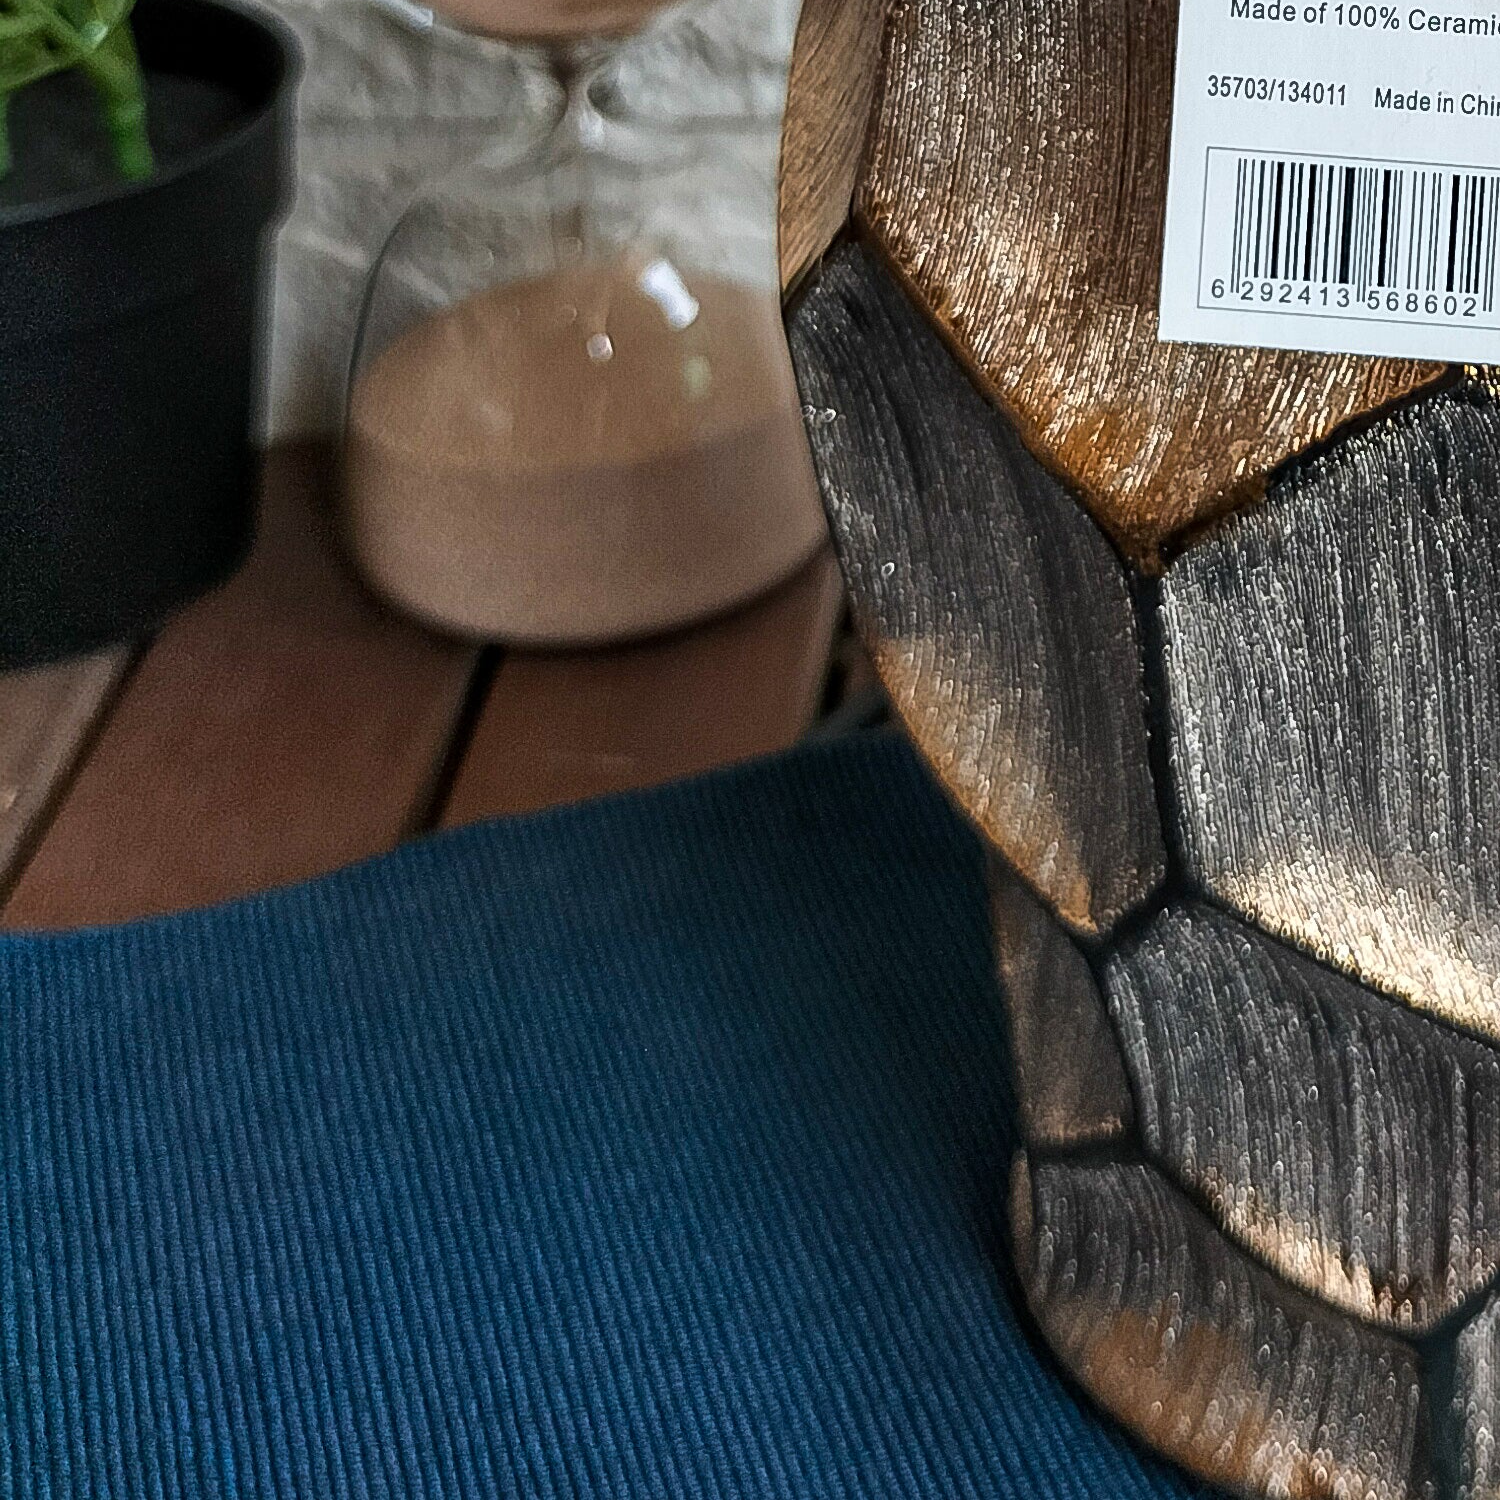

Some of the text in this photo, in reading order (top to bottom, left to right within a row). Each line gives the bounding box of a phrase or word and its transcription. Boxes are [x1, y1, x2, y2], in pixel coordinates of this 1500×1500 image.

[1303, 2, 1328, 24] of
[1334, 3, 1400, 30] 100%
[1207, 74, 1347, 107] 35703/134011
[1374, 87, 1431, 112] Made
[1437, 92, 1454, 114] in
